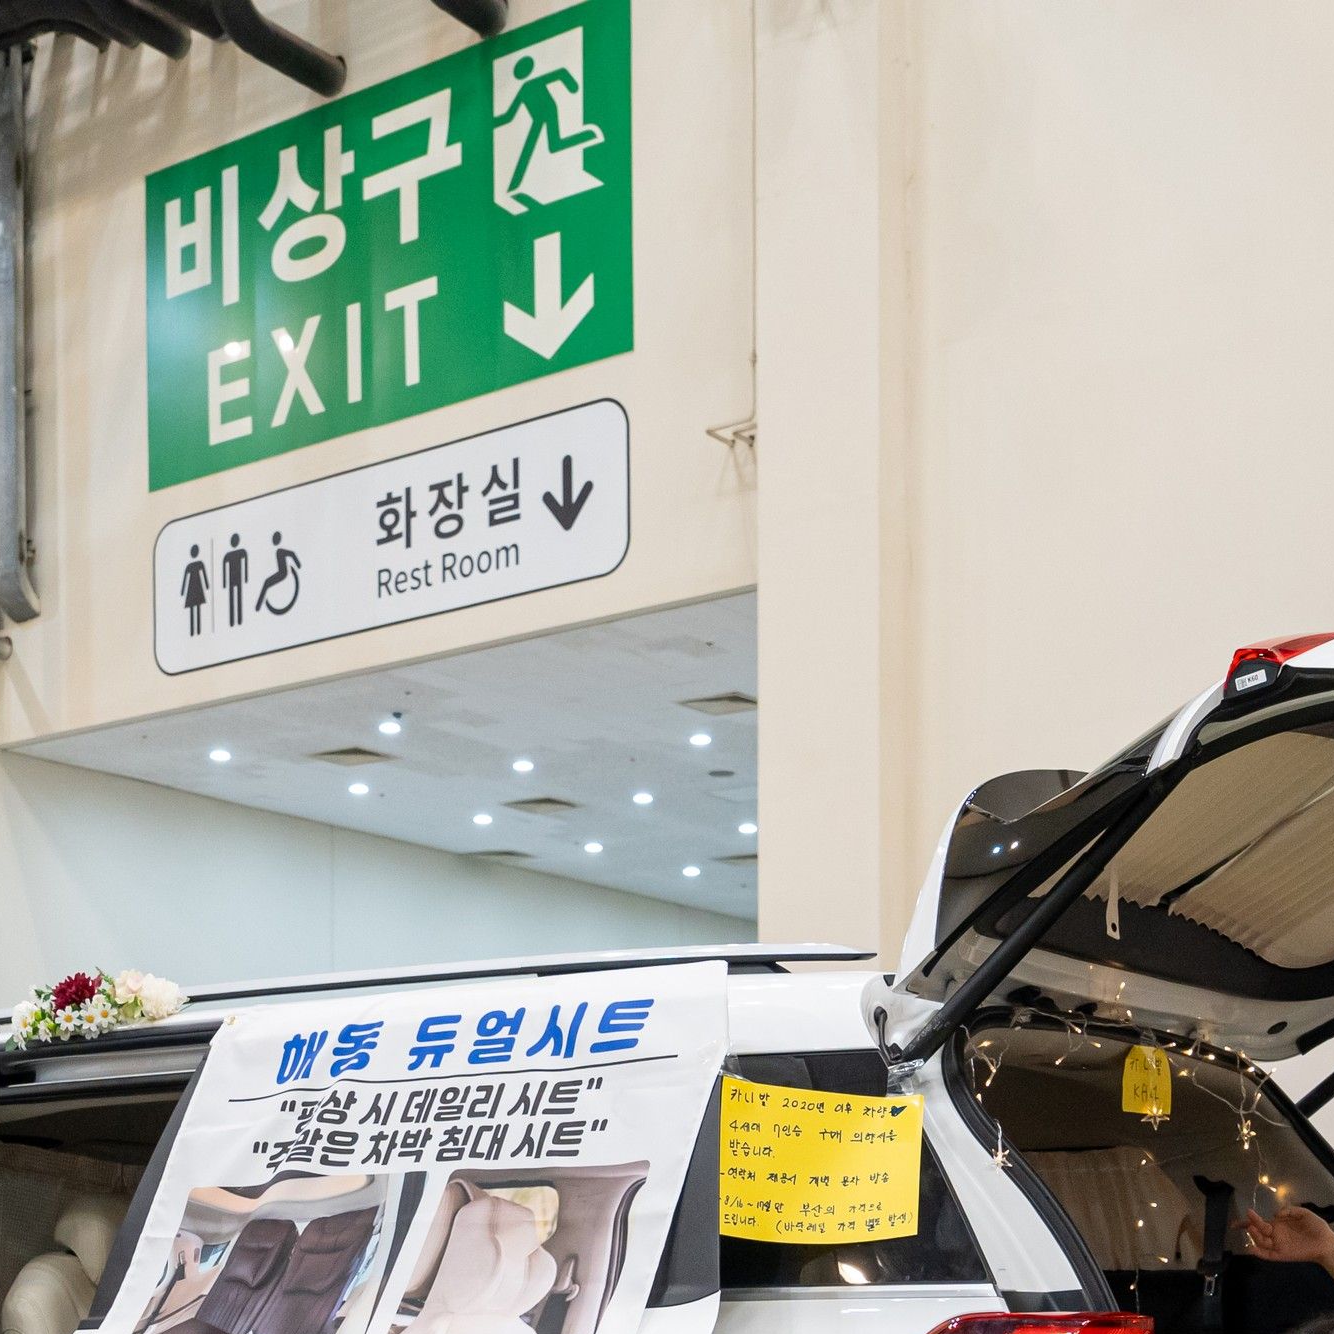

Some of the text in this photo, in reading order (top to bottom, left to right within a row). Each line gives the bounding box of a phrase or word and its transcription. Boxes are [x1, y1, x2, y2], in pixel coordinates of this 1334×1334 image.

[164, 86, 463, 308] 비상구
[207, 275, 439, 447] EXIT
[375, 456, 523, 551] 화장실
[376, 540, 521, 599] Rest Room
[275, 998, 655, 1086] 해동 듀얼시트
[400, 1082, 500, 1124] 데일리
[730, 1088, 771, 1108] 카니발
[782, 1098, 825, 1114] 2020년
[360, 1127, 434, 1166] 차박
[435, 1122, 510, 1163] 침대
